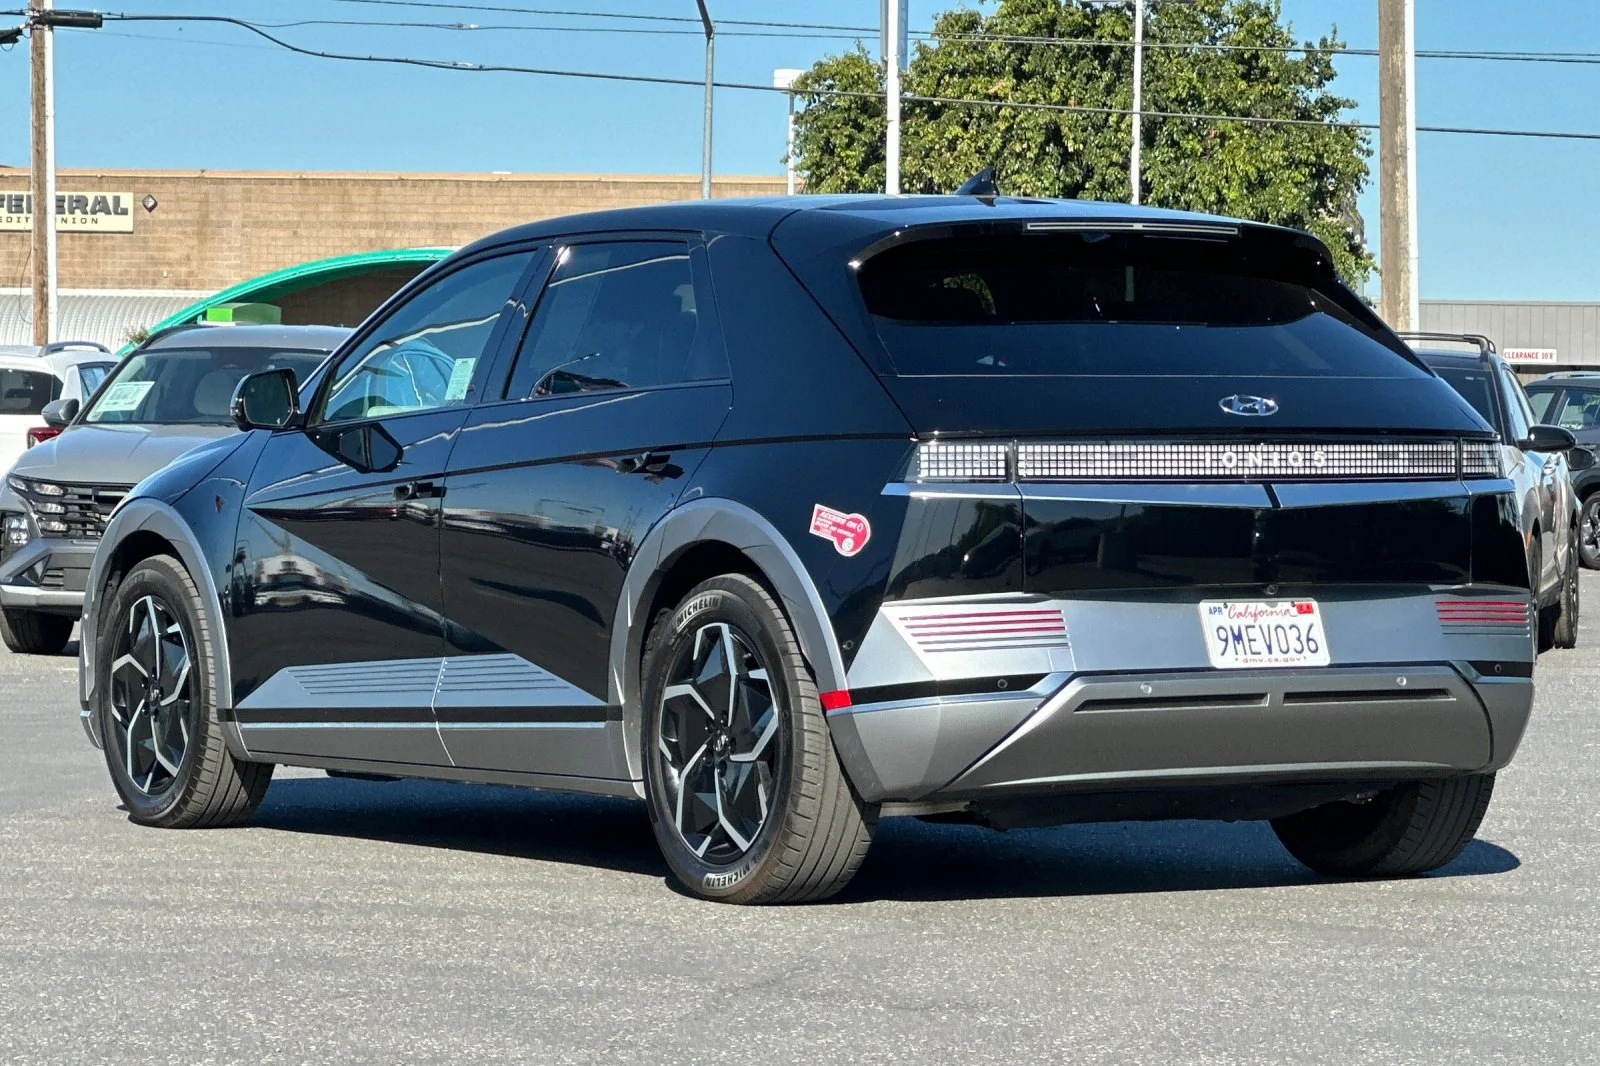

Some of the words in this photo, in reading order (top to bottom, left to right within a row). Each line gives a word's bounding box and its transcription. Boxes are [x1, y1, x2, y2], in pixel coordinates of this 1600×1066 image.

[55, 217, 98, 225] NION
[1313, 450, 1327, 468] 5
[677, 597, 720, 627] MICHELIN
[1208, 606, 1223, 615] APR
[1228, 604, 1298, 623] California
[1216, 623, 1319, 656] 9MEV036
[704, 864, 750, 887] MICHELIN
